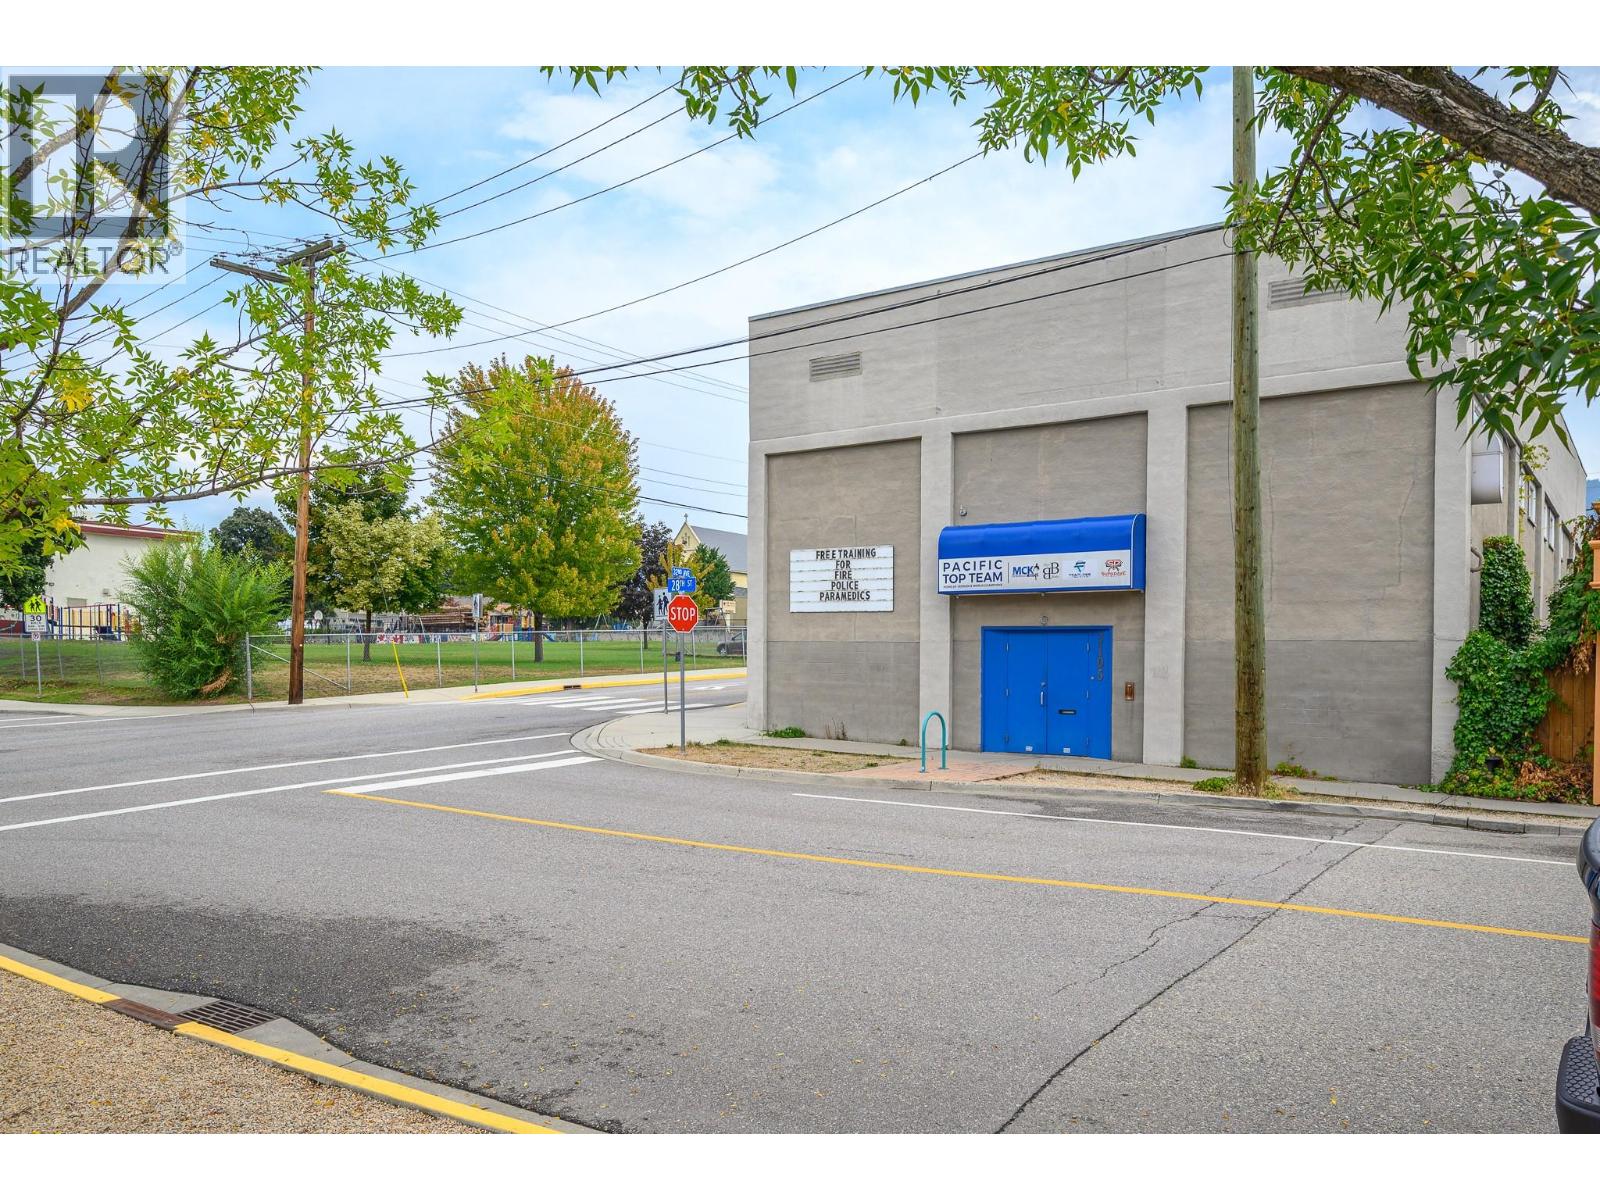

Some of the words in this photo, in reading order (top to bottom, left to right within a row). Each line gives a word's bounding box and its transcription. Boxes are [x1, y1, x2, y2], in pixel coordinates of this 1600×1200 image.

[815, 550, 836, 560] FREE
[838, 547, 876, 559] TRAINING
[835, 560, 851, 569] FOR
[943, 559, 1003, 572] PACIFIC
[834, 570, 853, 580] FIRE
[942, 573, 966, 584] TOP
[968, 571, 1003, 583] TEAM
[671, 579, 685, 591] 28TH
[831, 581, 859, 590] POLICE
[819, 590, 871, 601] PARAMEDICS
[670, 607, 696, 621] STOP
